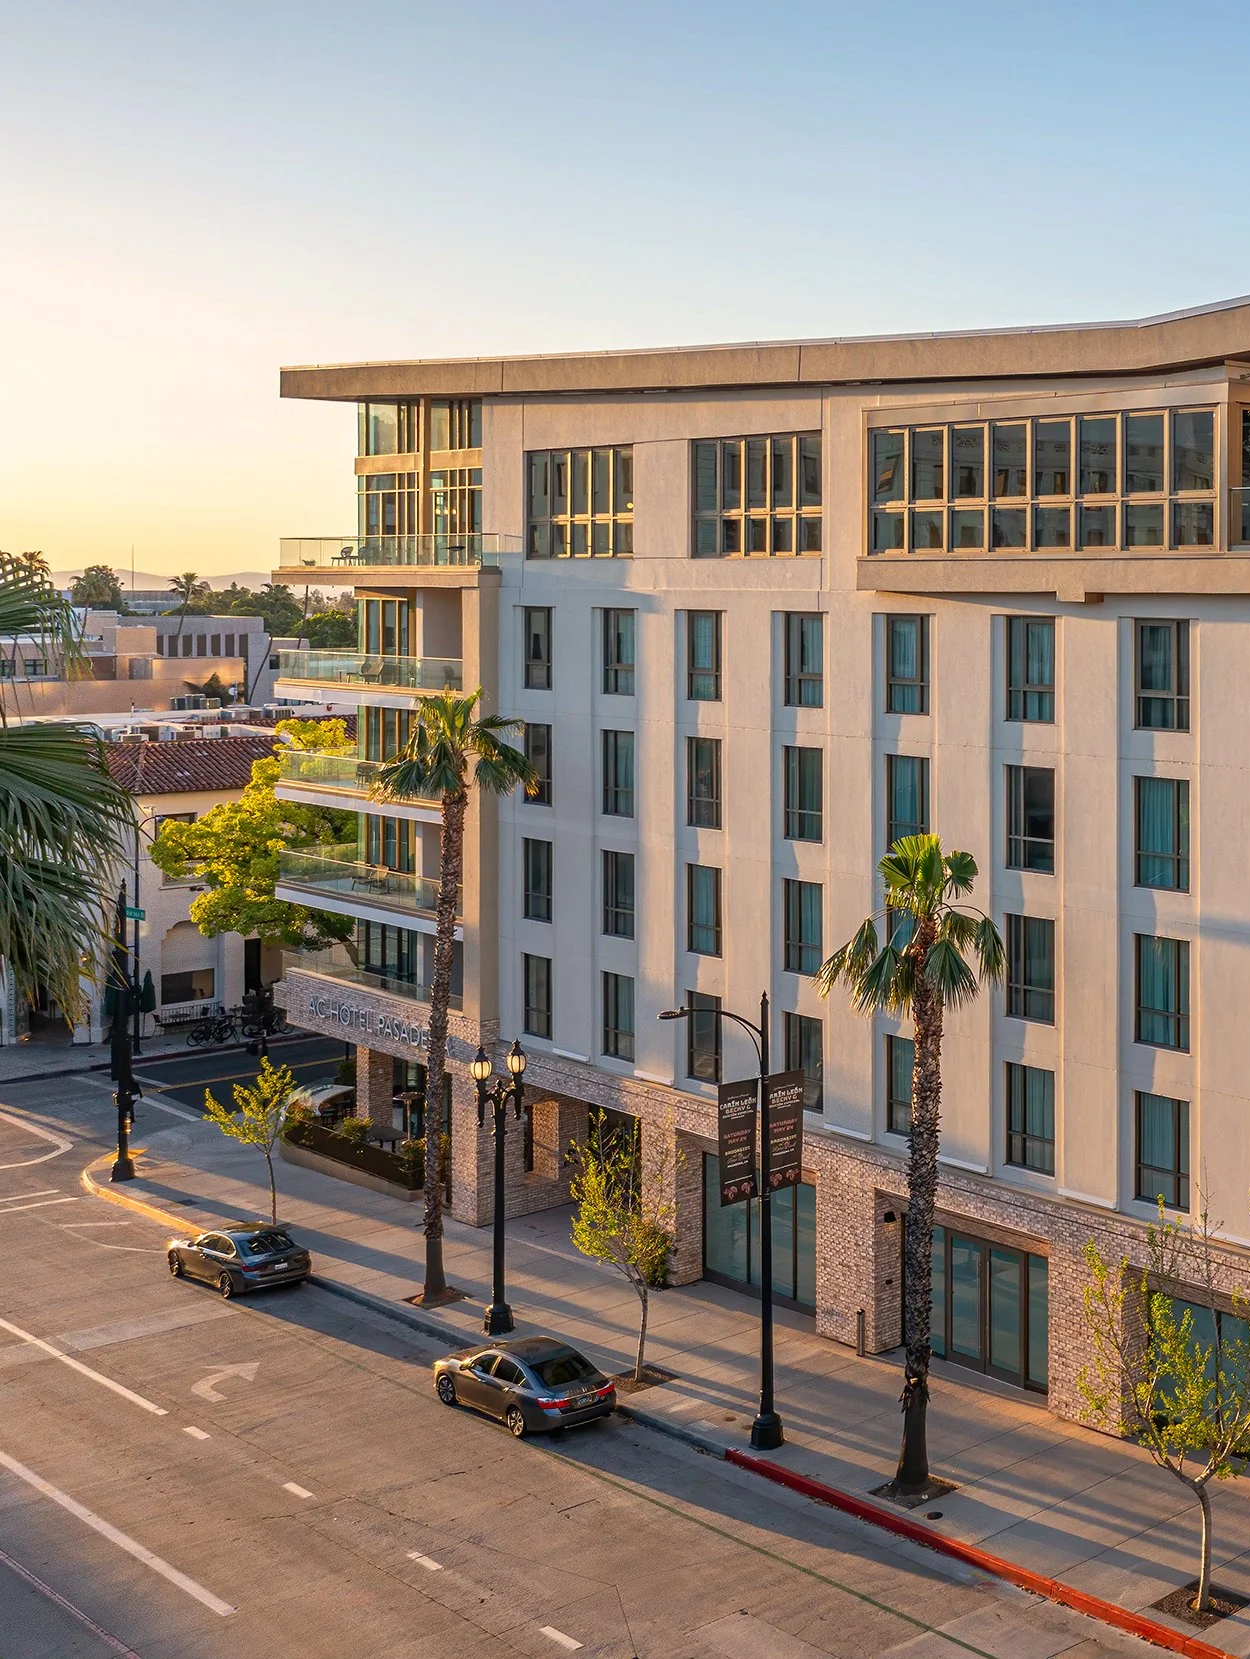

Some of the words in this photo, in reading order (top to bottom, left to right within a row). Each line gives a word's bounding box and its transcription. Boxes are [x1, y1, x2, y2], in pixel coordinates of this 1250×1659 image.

[309, 997, 326, 1018] AC
[330, 1001, 373, 1033] HOTEL
[379, 1015, 450, 1057] PASADE
[769, 1118, 798, 1128] SATURDAY
[724, 1129, 752, 1139] SATURDAY
